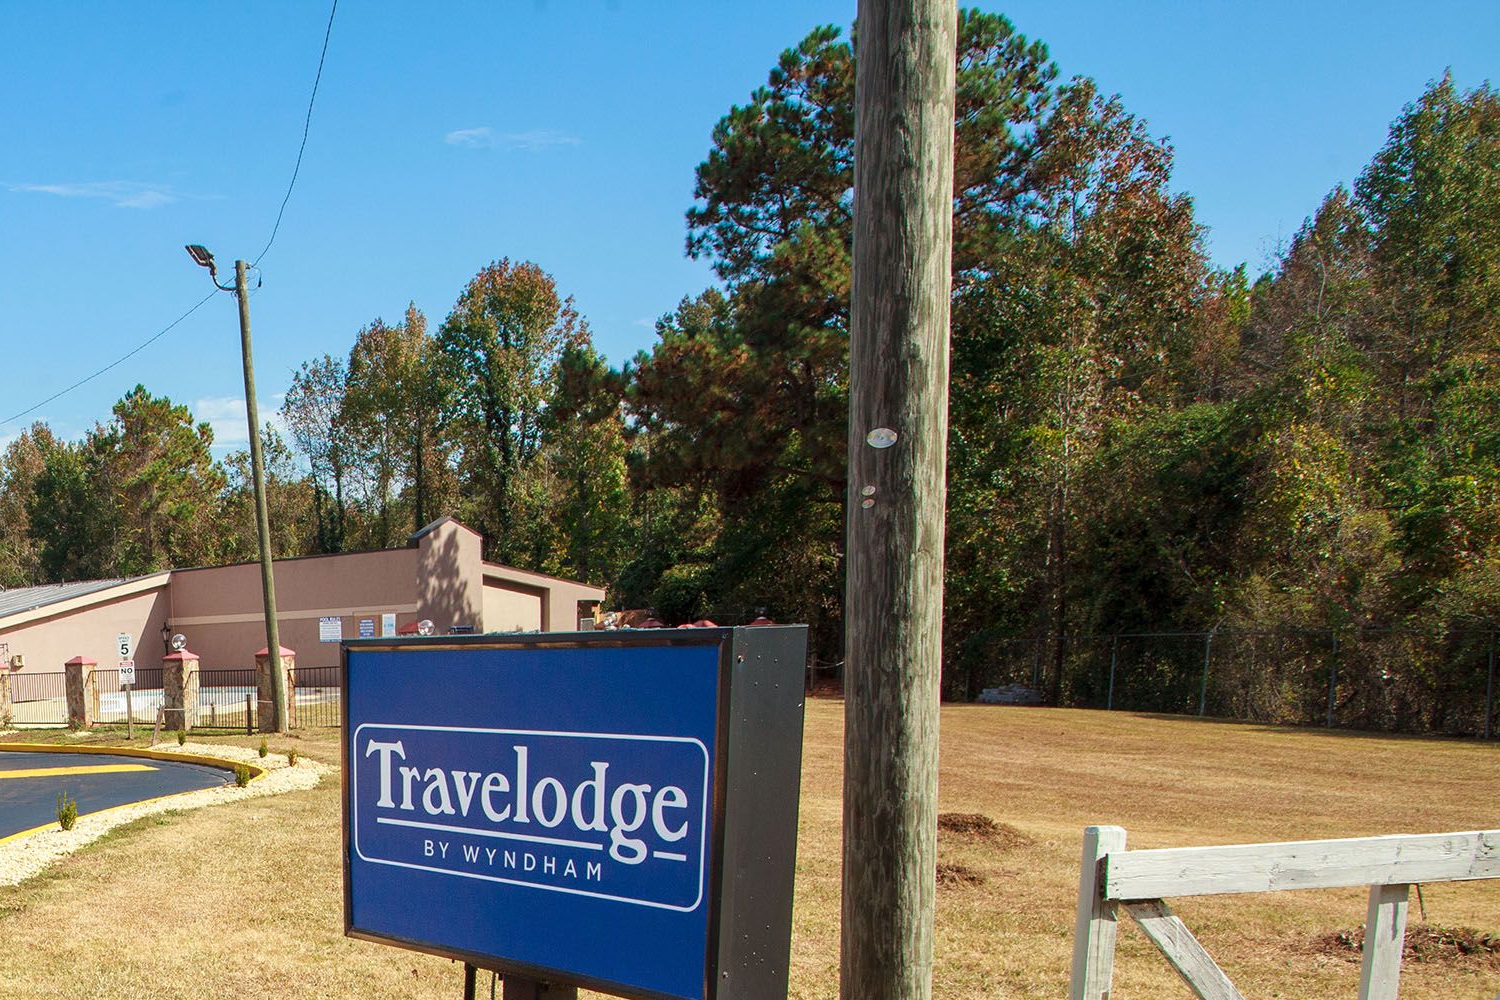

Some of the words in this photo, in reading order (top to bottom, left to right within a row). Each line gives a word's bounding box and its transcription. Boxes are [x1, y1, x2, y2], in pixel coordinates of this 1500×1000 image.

[121, 643, 129, 655] 5
[366, 738, 688, 865] Travelodge
[424, 839, 449, 859] BY
[463, 844, 601, 882] WYNDHAM
